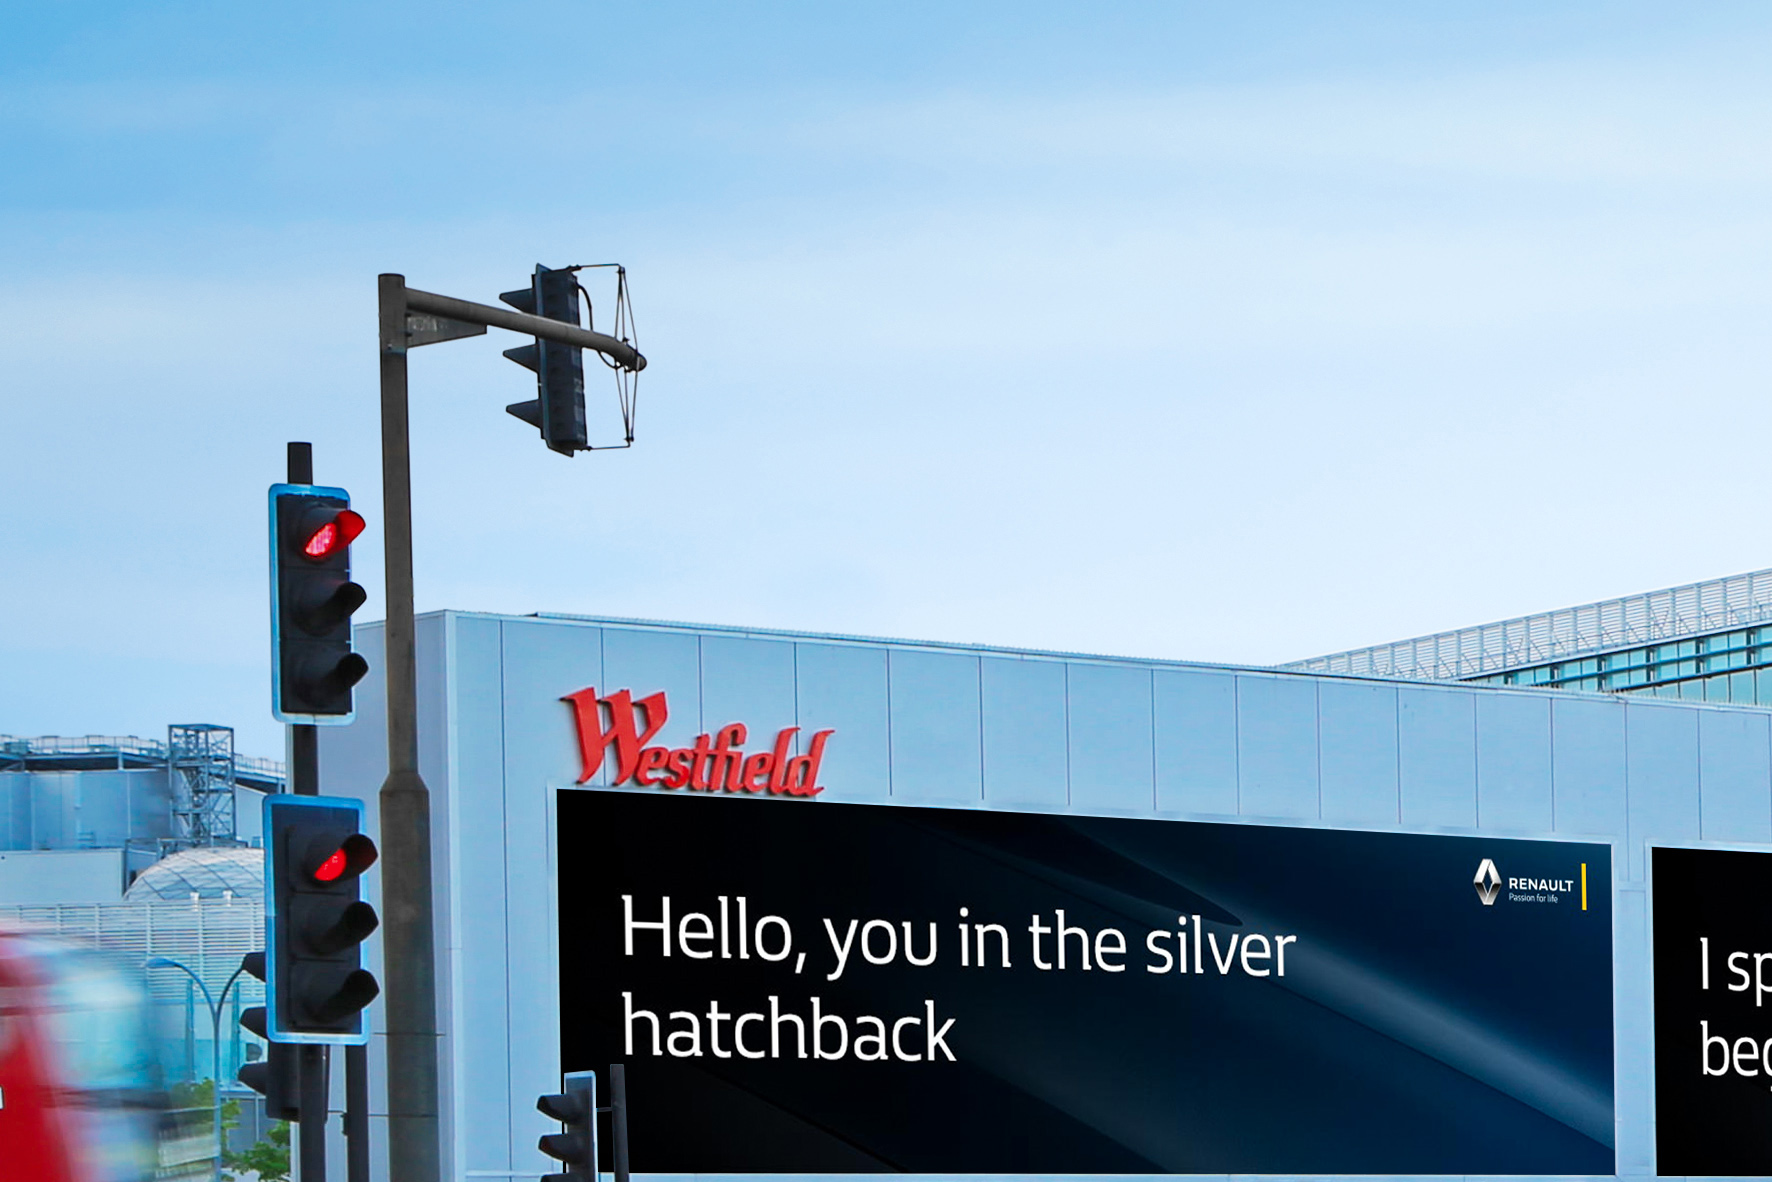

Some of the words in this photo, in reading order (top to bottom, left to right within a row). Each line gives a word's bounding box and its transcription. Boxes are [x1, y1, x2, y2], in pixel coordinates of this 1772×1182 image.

[559, 687, 835, 797] Westfield
[1508, 878, 1574, 893] RENAULT
[1508, 893, 1536, 902] Passion
[1537, 894, 1547, 903] for
[1547, 895, 1559, 904] life
[622, 895, 806, 974] Hello,
[823, 919, 937, 981] you
[959, 907, 1012, 968] in
[1029, 910, 1127, 973] the
[1146, 915, 1297, 977] silver
[1699, 937, 1709, 990] I
[622, 992, 957, 1062] hatchback
